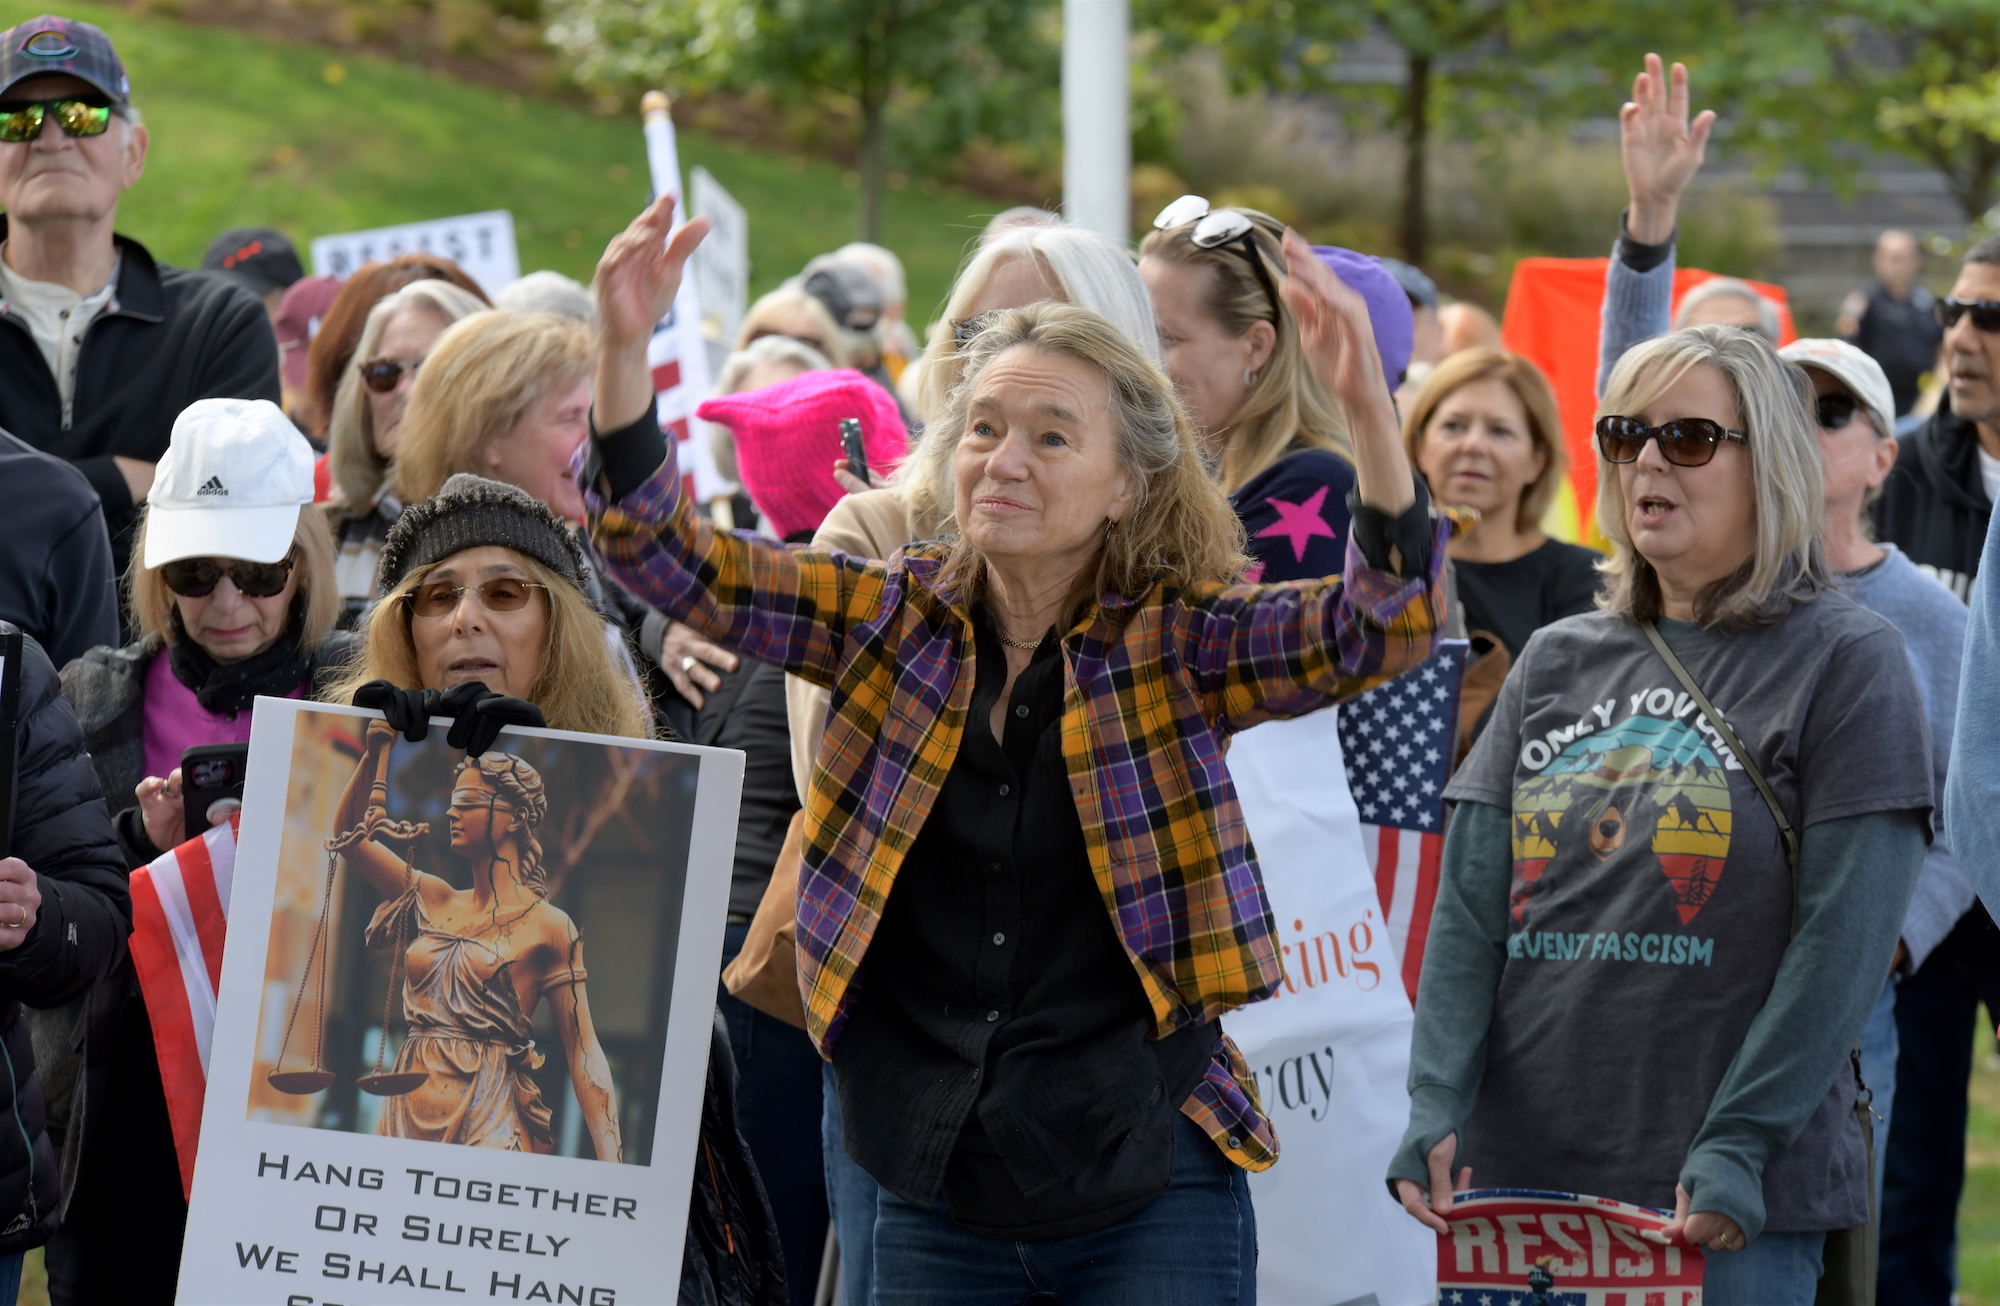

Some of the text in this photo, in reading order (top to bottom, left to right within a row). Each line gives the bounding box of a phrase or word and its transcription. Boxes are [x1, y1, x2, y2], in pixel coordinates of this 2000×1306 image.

[197, 488, 229, 496] adidas
[1521, 699, 1616, 771] ONLY
[1630, 687, 1697, 718] YOU
[1507, 931, 1714, 966] EVENT FASCISM
[257, 1152, 638, 1220] HANG TOGETHER
[314, 1205, 571, 1257] OR SURELY
[1448, 1213, 1682, 1278] RESIST
[235, 1242, 617, 1306] WE SHALL HANG
